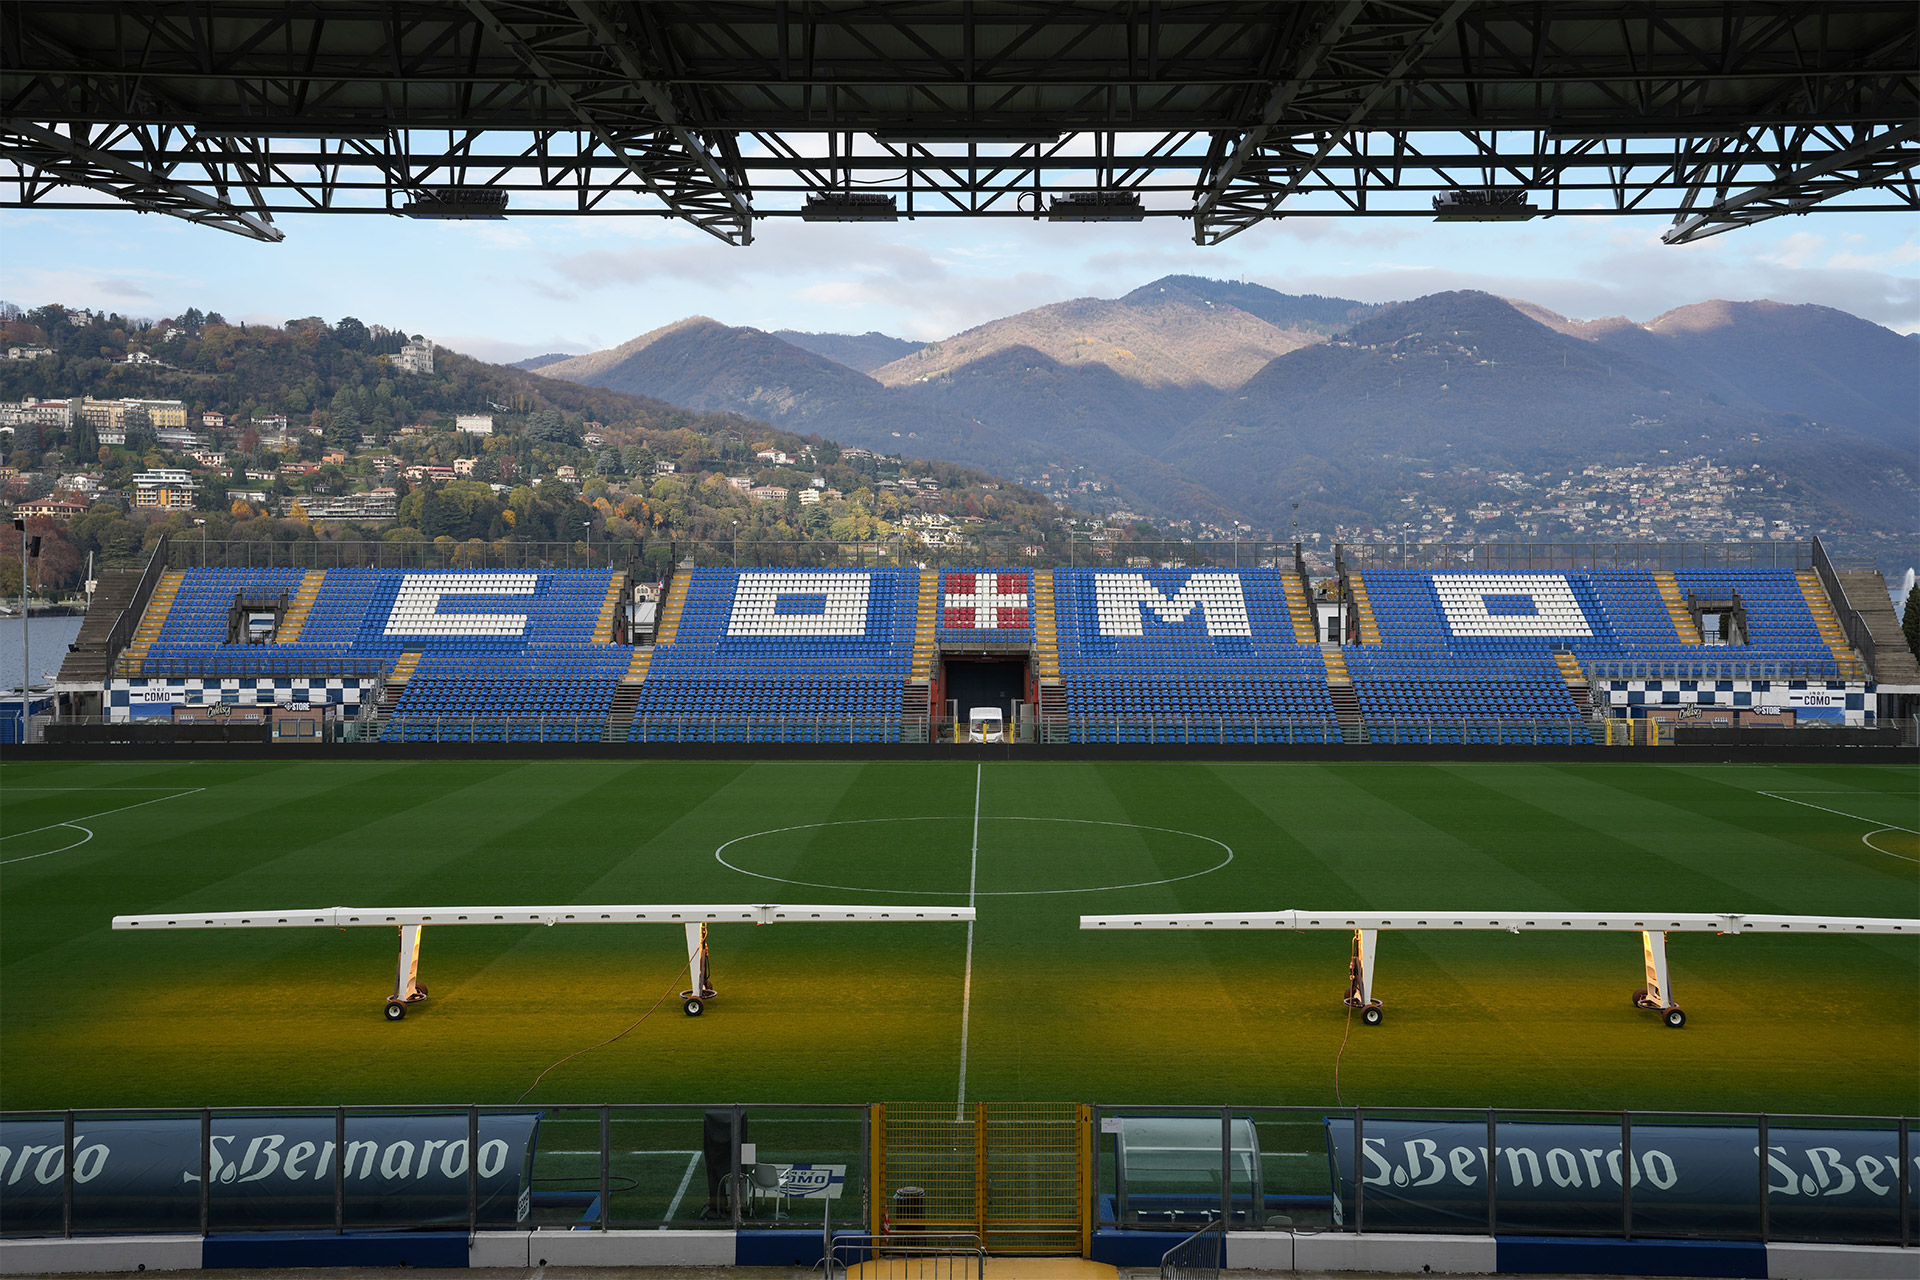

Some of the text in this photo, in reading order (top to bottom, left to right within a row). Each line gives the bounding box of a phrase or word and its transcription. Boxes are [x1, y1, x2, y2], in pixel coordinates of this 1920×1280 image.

[144, 692, 171, 702] COMO
[1804, 696, 1831, 706] COMO
[291, 702, 311, 711] STORE
[1761, 706, 1781, 715] STORE
